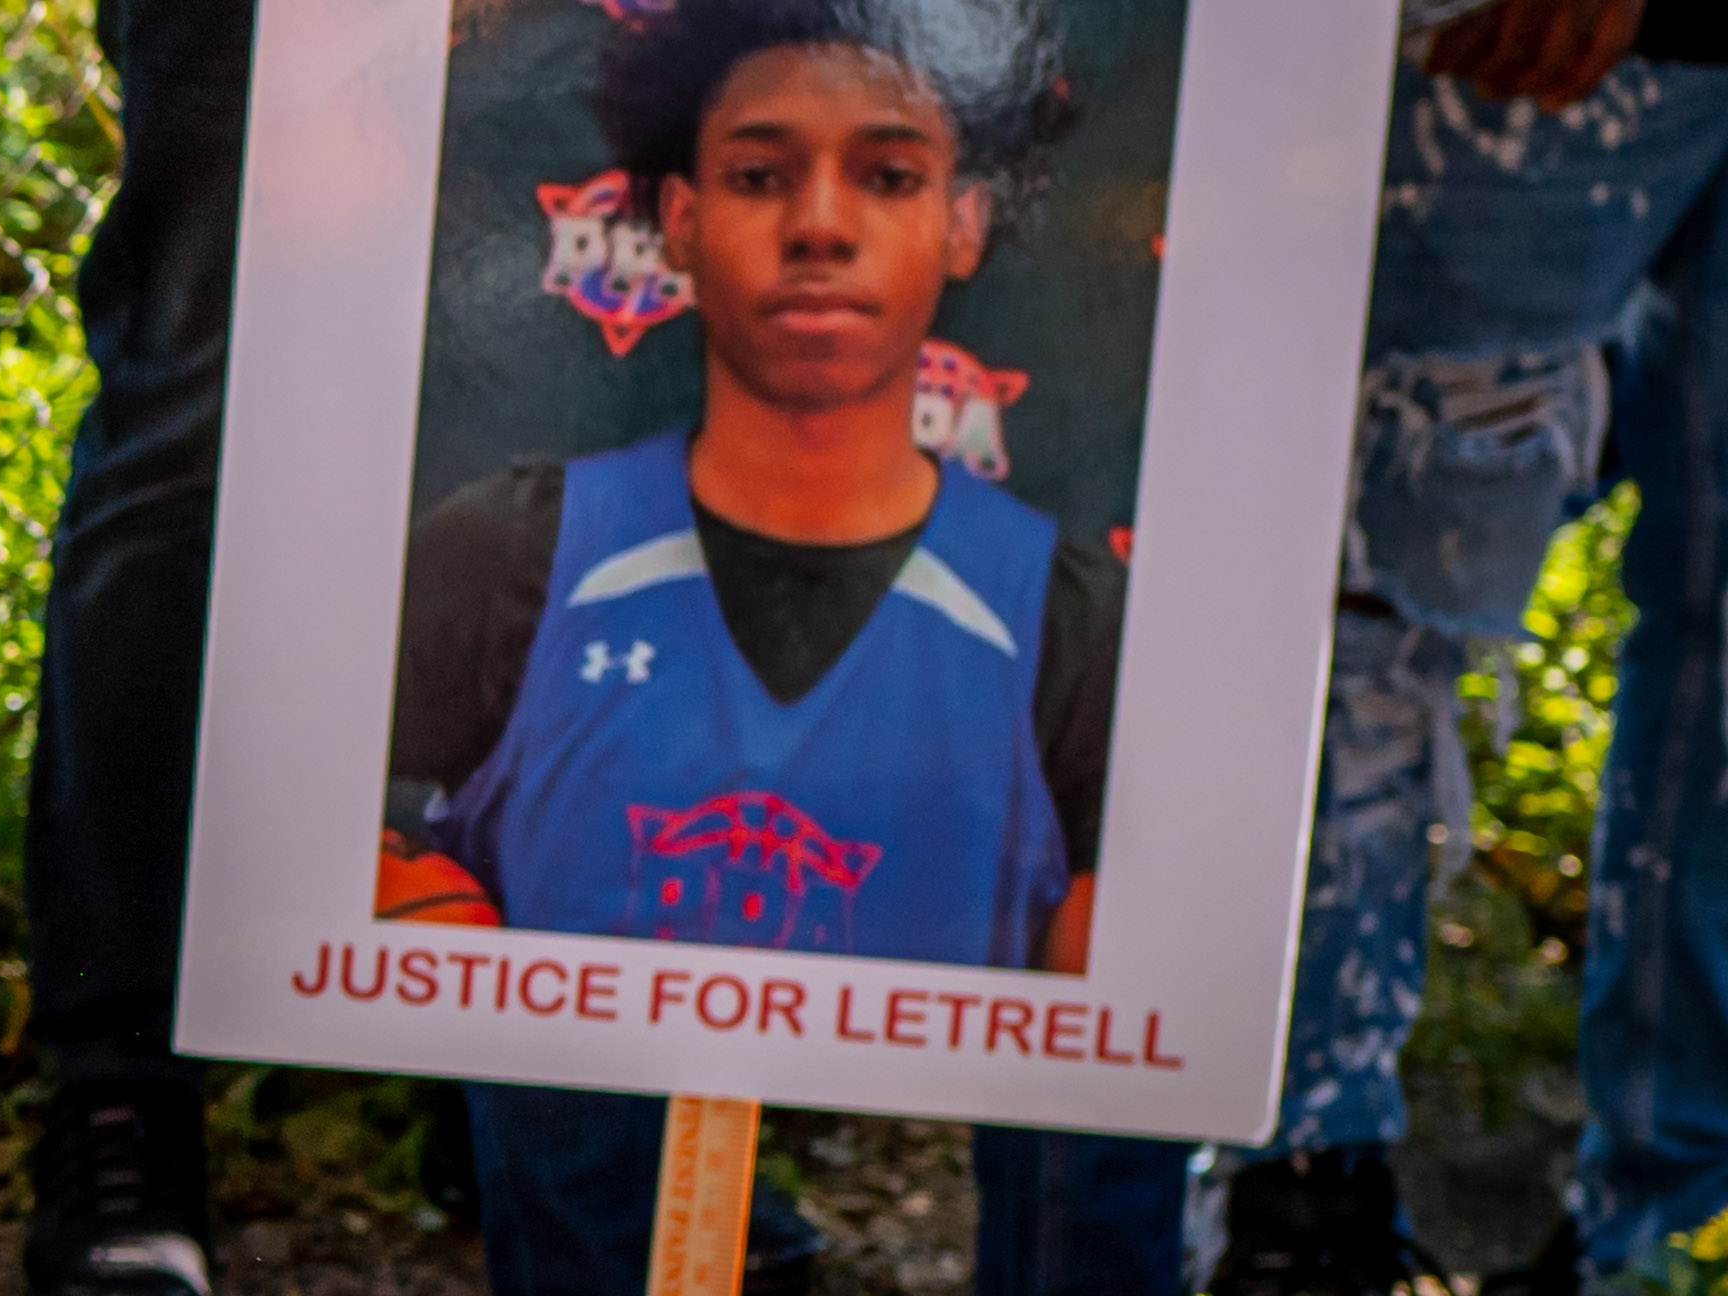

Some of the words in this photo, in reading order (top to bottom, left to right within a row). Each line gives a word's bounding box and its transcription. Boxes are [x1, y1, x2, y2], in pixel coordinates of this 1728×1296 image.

[291, 944, 619, 1021] JUSTICE
[647, 970, 808, 1037] FOR
[835, 987, 1182, 1069] LETRELL
